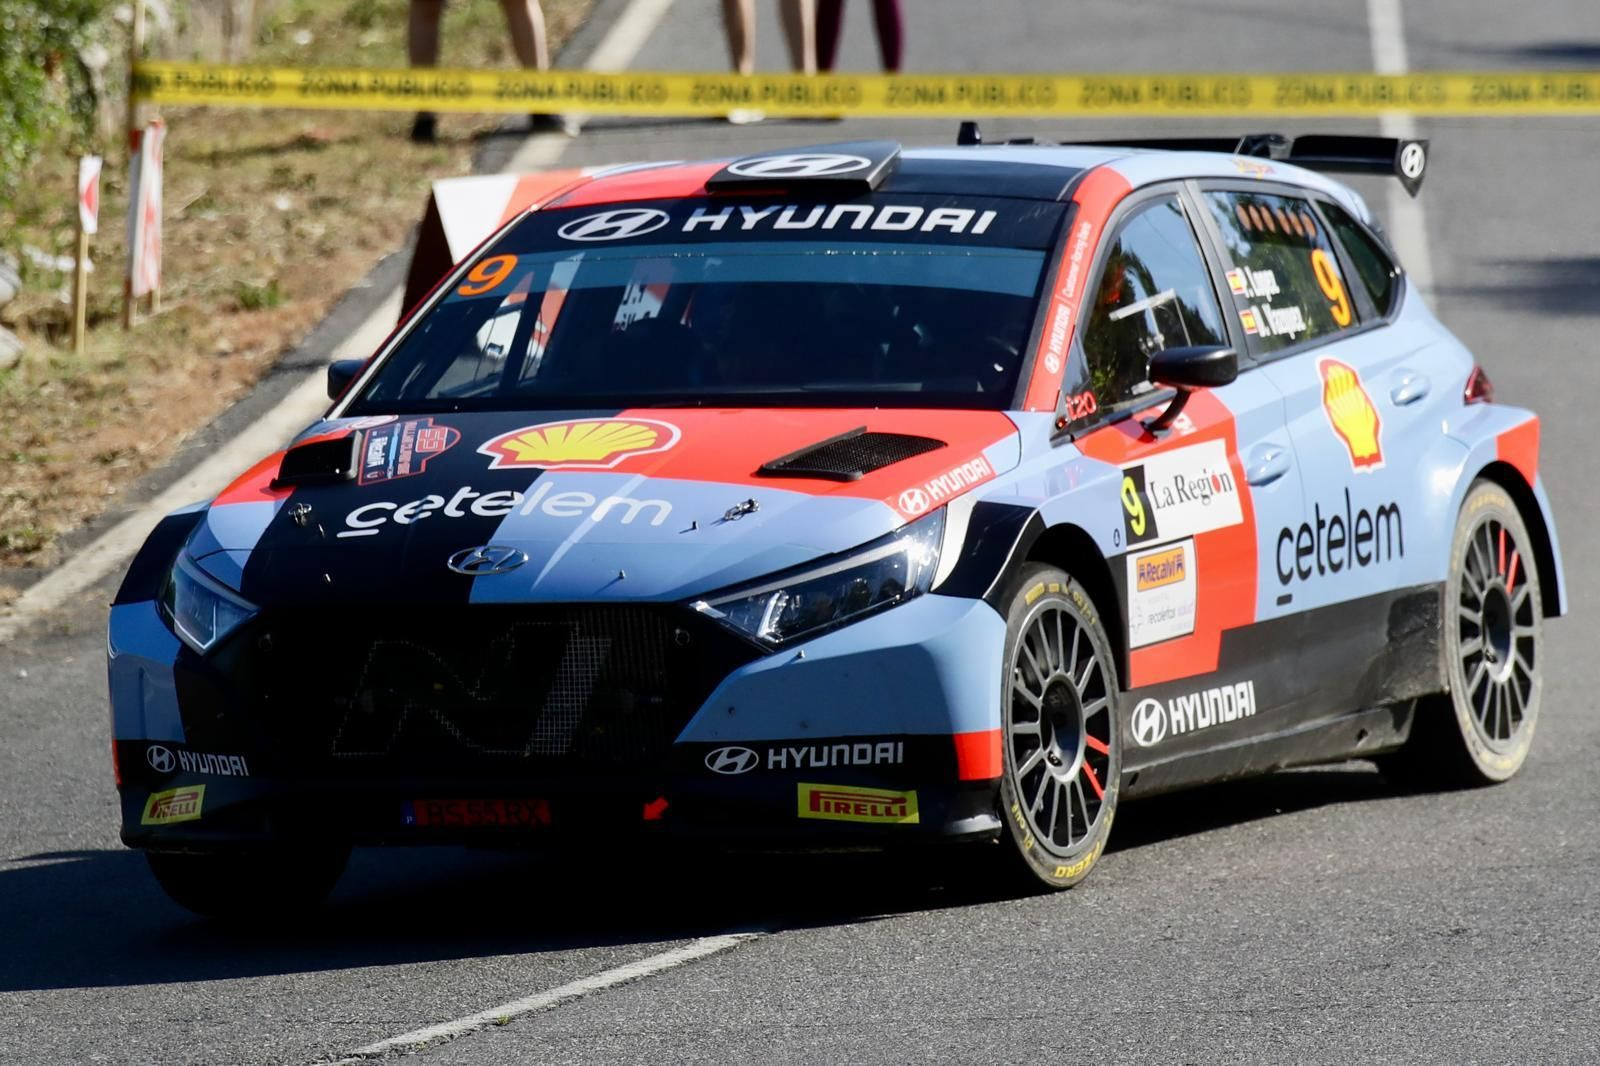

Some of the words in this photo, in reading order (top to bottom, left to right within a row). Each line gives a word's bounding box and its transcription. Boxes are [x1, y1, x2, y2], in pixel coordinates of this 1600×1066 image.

[681, 204, 997, 236] HYUNDAI
[457, 253, 519, 297] 9
[1311, 248, 1352, 327] 9
[1049, 302, 1071, 354] HYUNDAI
[924, 456, 993, 501] HYUNDAI
[1149, 480, 1176, 510] La
[1174, 467, 1233, 507] Región
[340, 482, 674, 532] cetelem
[1120, 476, 1146, 537] 9
[1276, 486, 1404, 590] cetelem
[1168, 679, 1256, 736] HYUNDAI
[177, 750, 250, 777] HYUNDAI
[767, 742, 904, 769] HYUNDAI
[148, 791, 199, 819] PIRELLI
[808, 789, 908, 818] PIRELLI
